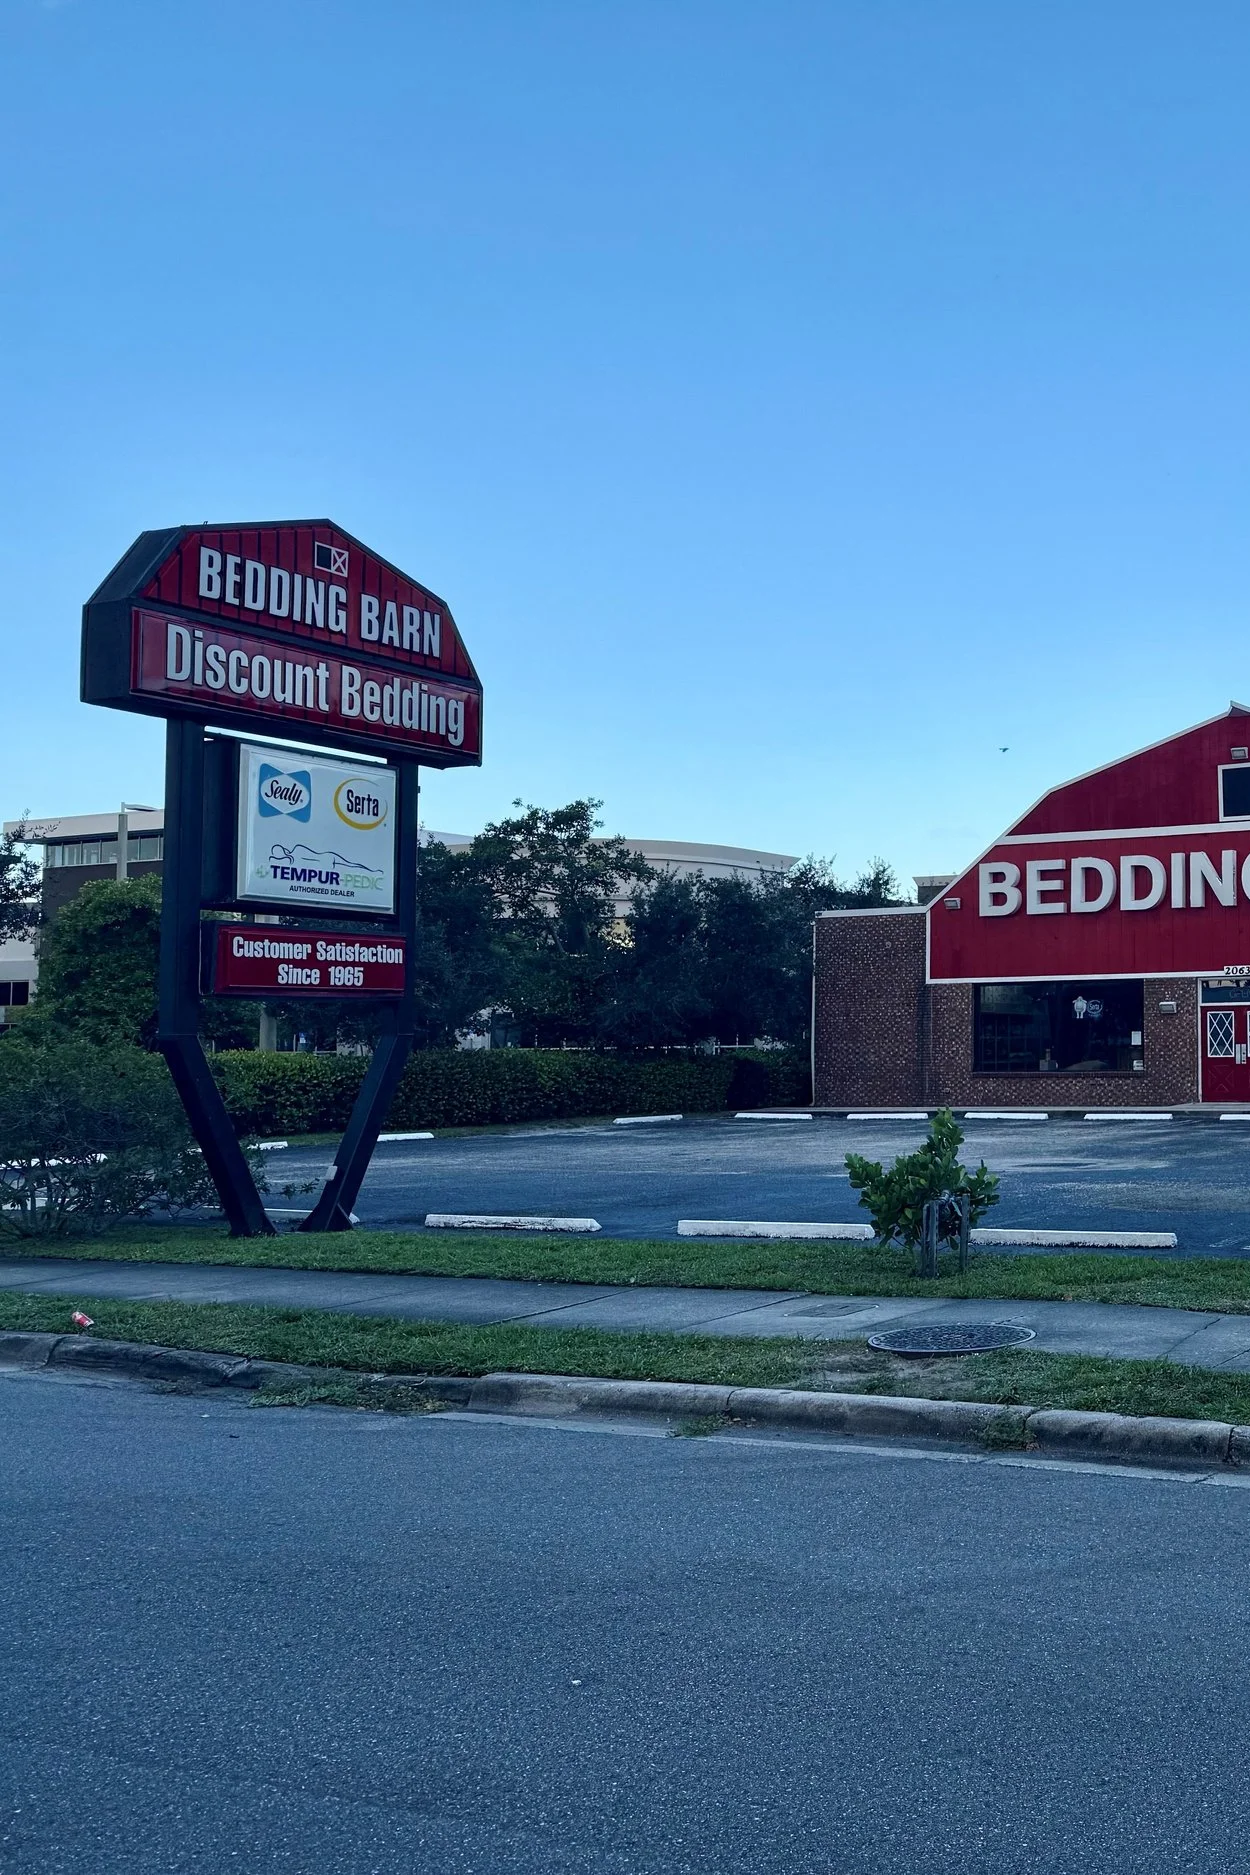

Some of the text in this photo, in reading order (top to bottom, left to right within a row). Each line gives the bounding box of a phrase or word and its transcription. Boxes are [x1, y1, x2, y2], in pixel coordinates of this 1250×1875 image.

[199, 546, 442, 658] BEDDING BARN
[166, 623, 465, 746] Discount Bedding
[264, 779, 303, 806] Sealy
[346, 789, 379, 817] Serta
[270, 865, 384, 891] TEMPUR-PEDIC
[289, 885, 355, 898] AUTHORIZED DEALER
[232, 936, 404, 964] Customer Satisfaction
[277, 964, 364, 986] Since 1965
[1225, 966, 1250, 975] 2063
